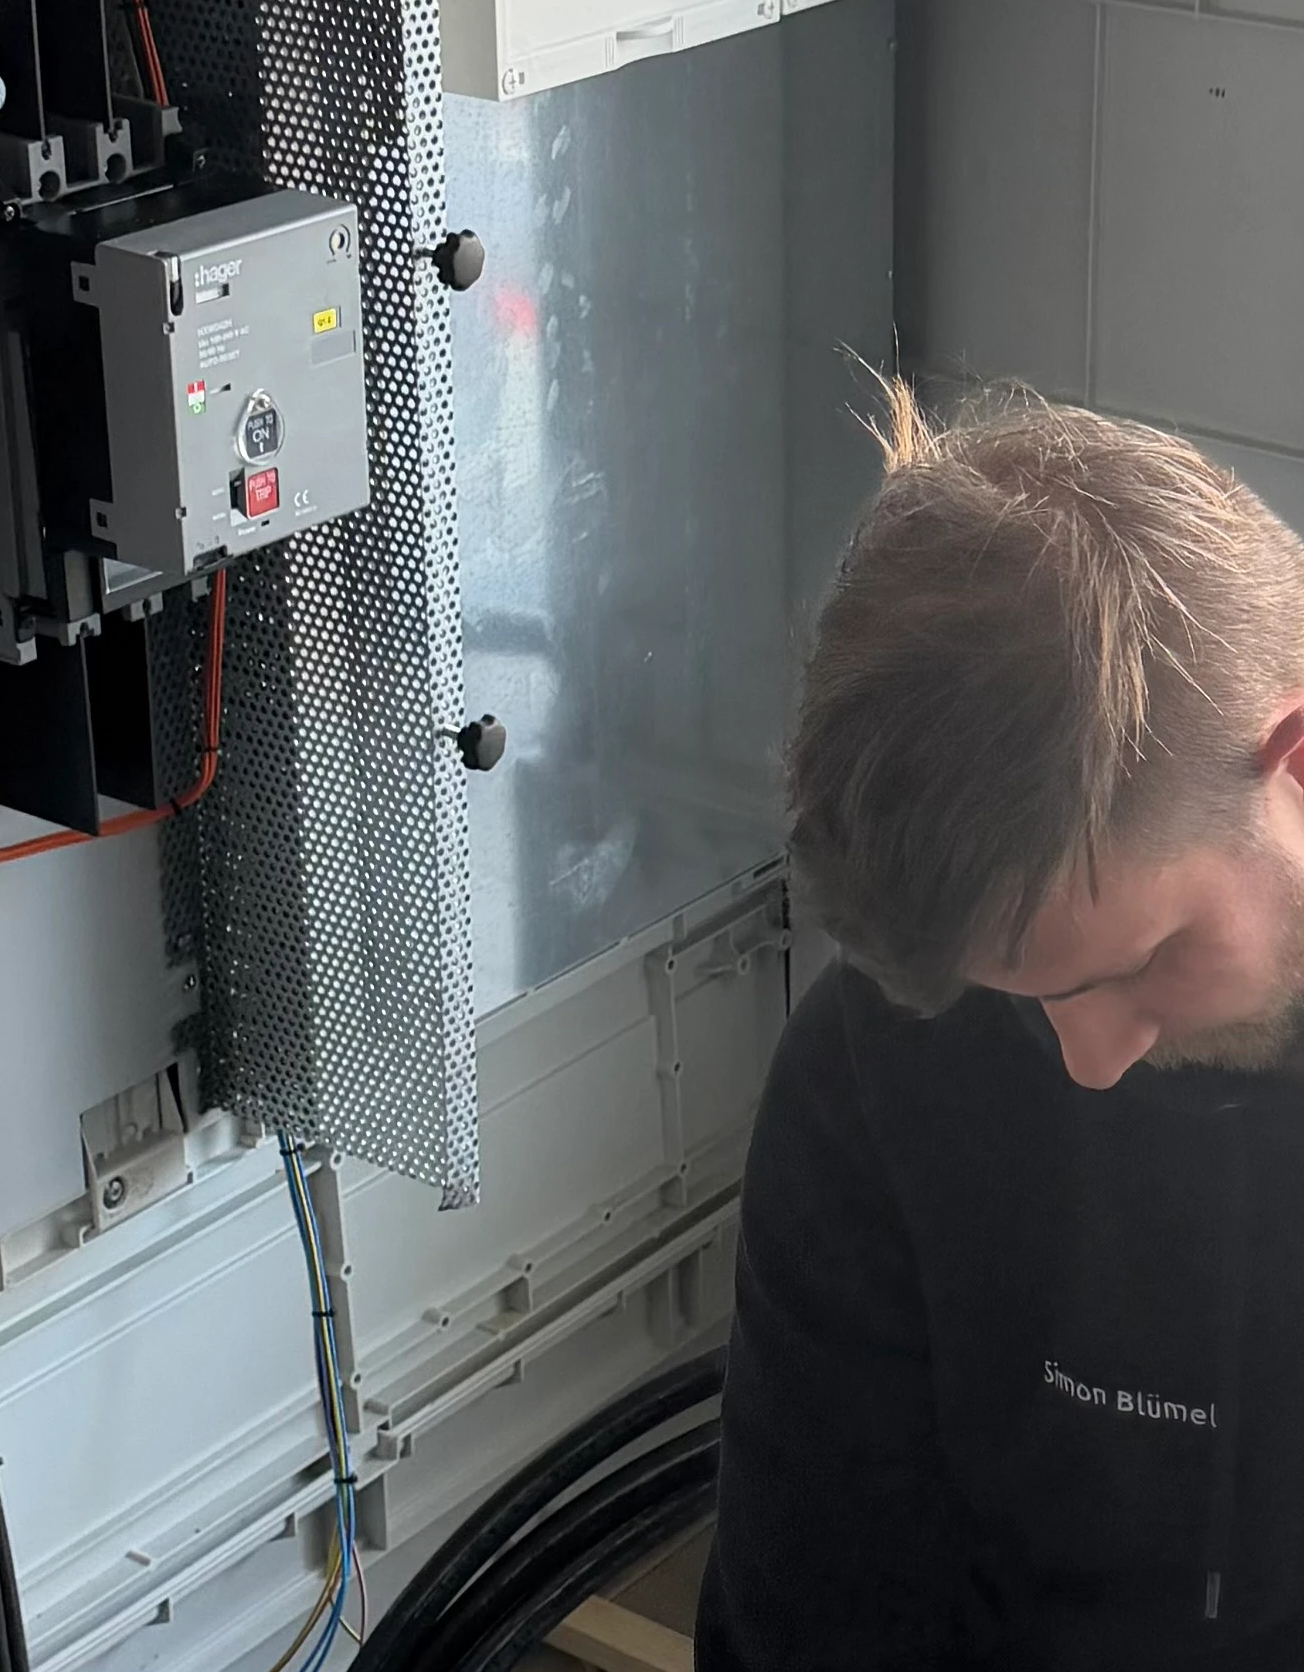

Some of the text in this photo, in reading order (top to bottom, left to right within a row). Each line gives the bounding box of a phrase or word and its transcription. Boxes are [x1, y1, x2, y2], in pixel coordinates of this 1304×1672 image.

[252, 427, 271, 443] ON
[1044, 1360, 1217, 1428] Simon Blümel
